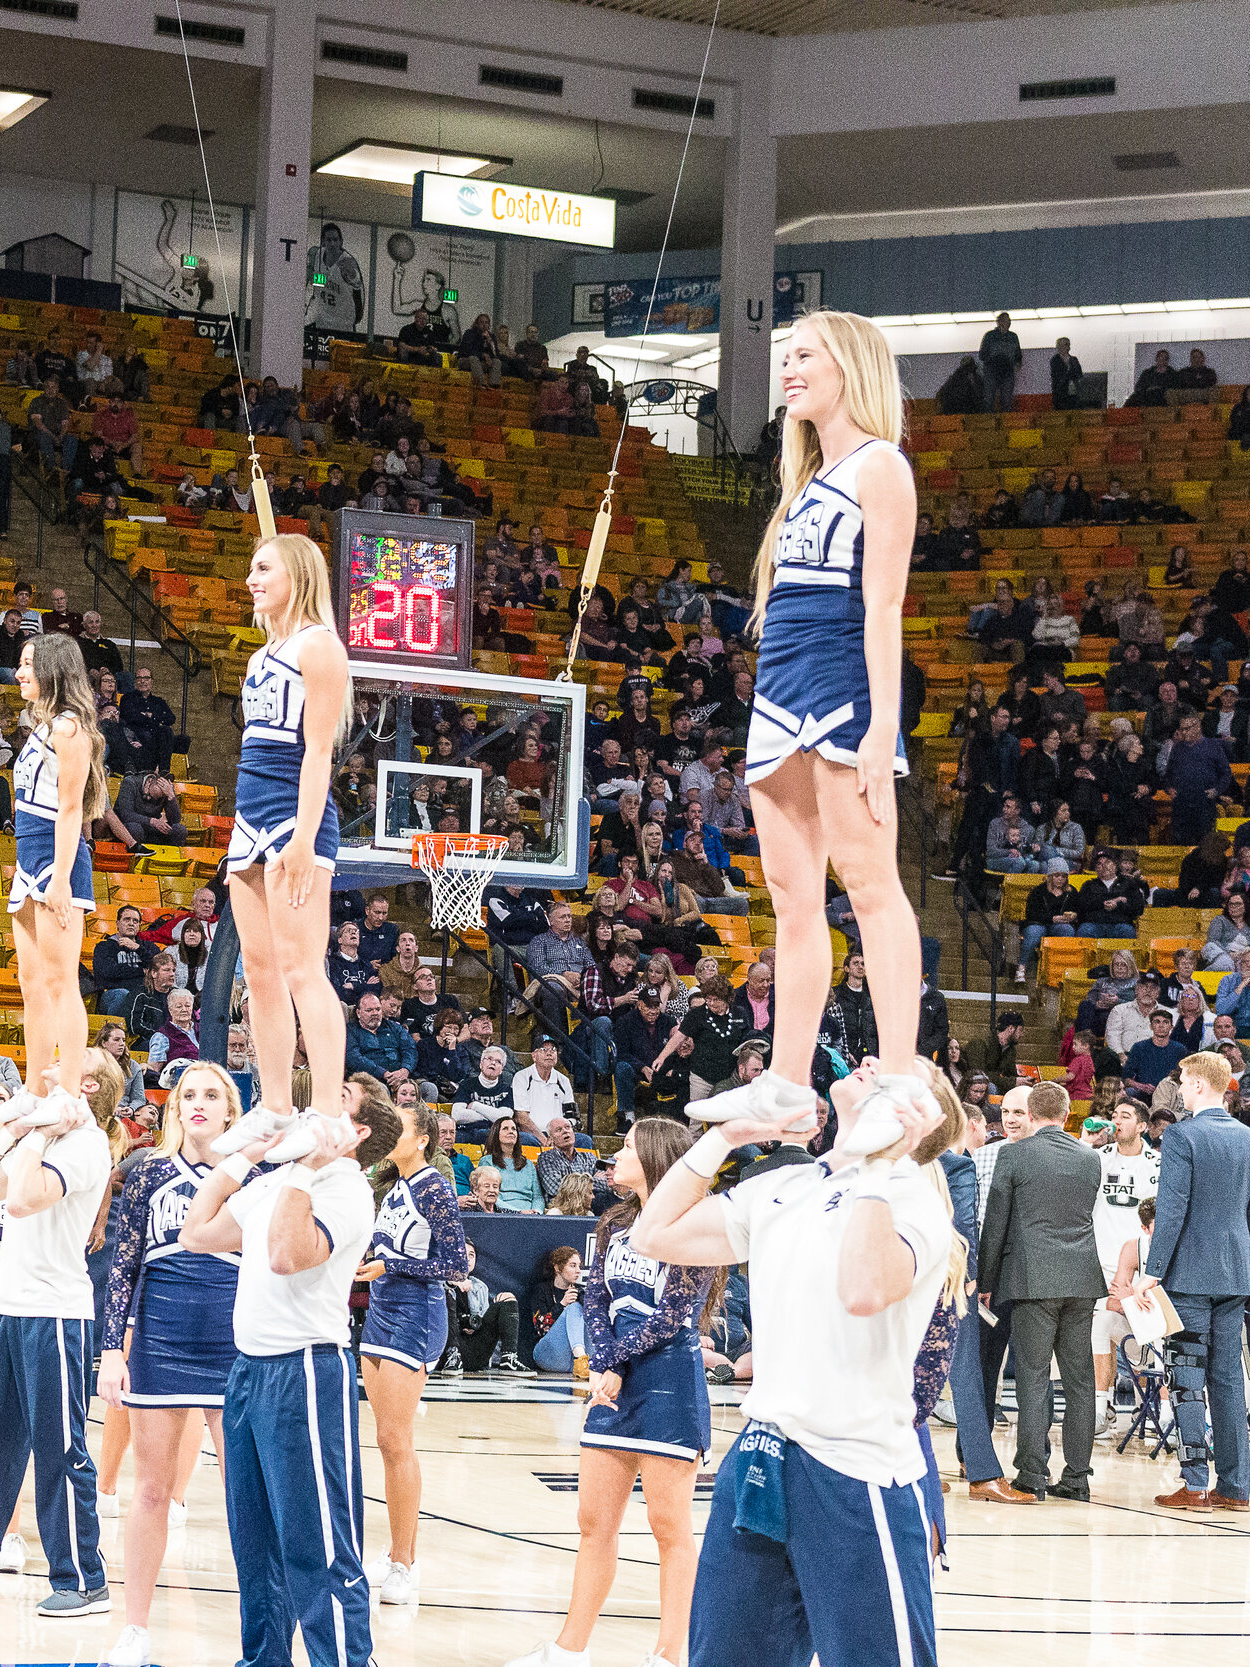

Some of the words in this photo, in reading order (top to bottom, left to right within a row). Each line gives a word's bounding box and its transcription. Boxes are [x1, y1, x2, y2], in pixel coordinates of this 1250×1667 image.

[279, 237, 297, 262] T
[747, 299, 763, 322] U
[367, 581, 440, 653] 20
[1102, 1184, 1135, 1195] STAT
[607, 1242, 658, 1287] AGGIES
